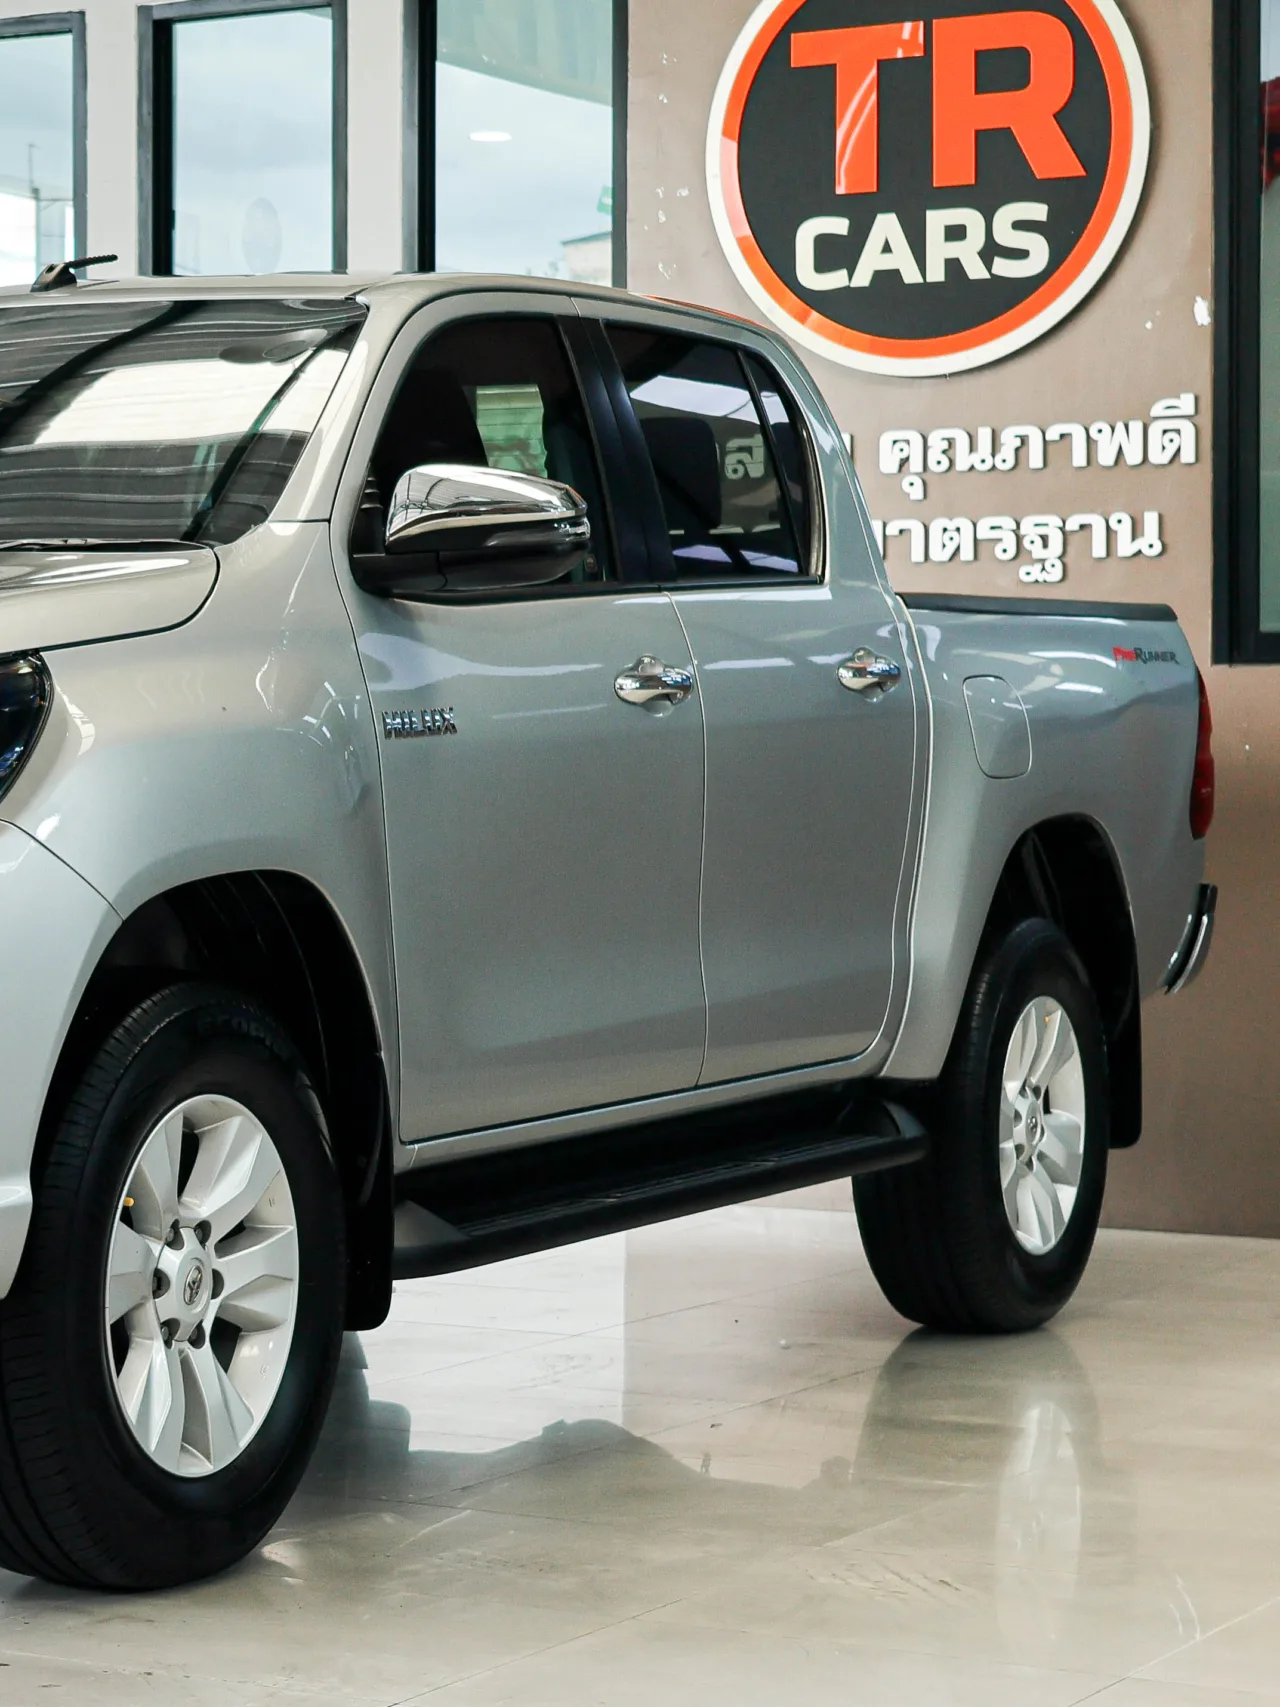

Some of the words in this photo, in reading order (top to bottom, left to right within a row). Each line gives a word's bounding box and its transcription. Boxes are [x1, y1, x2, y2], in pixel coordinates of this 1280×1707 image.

[790, 10, 1087, 195] TR
[795, 202, 1050, 291] CARS
[878, 393, 1197, 501] คุณภาพดี
[382, 707, 458, 740] HILUX
